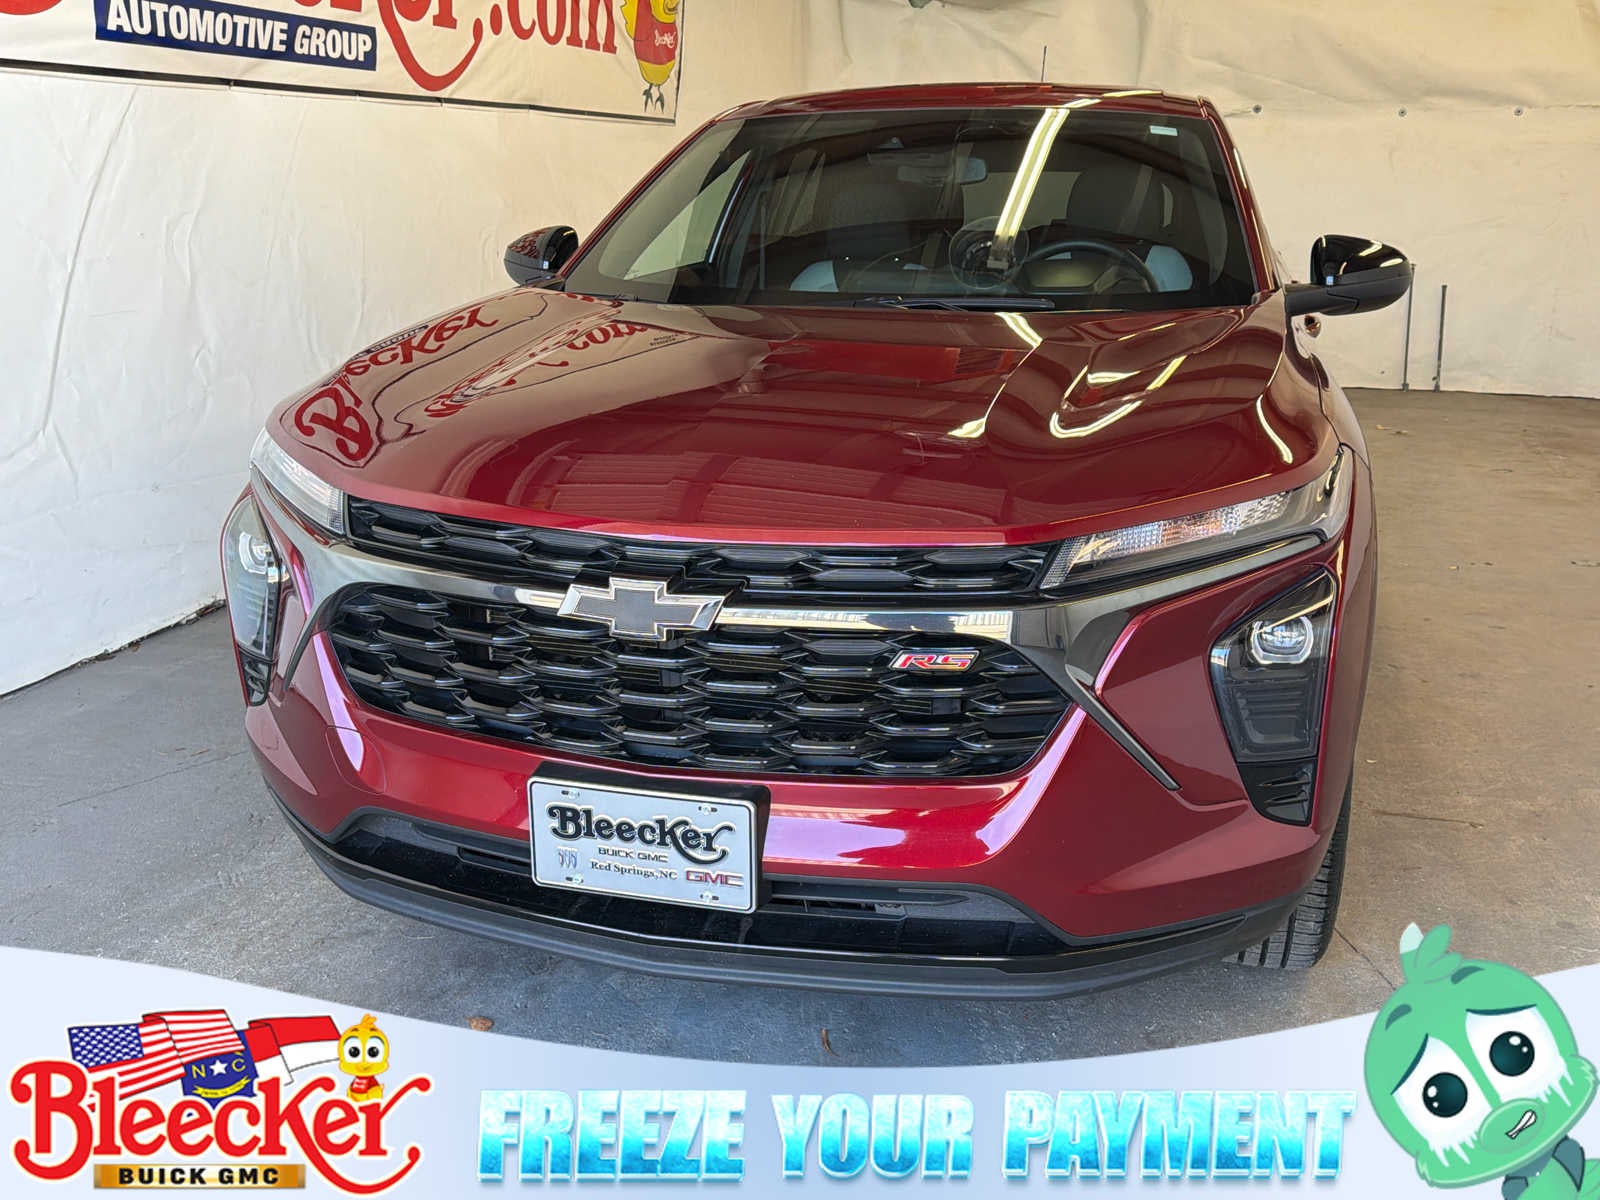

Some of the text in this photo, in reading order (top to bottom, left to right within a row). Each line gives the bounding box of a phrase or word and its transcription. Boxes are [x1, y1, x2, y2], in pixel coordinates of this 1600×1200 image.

[107, 0, 373, 62] AUTOMOTIVE GROUP
[891, 653, 976, 672] RS
[598, 846, 669, 863] BUICK GMC
[591, 861, 611, 872] Red
[686, 869, 745, 887] GMC
